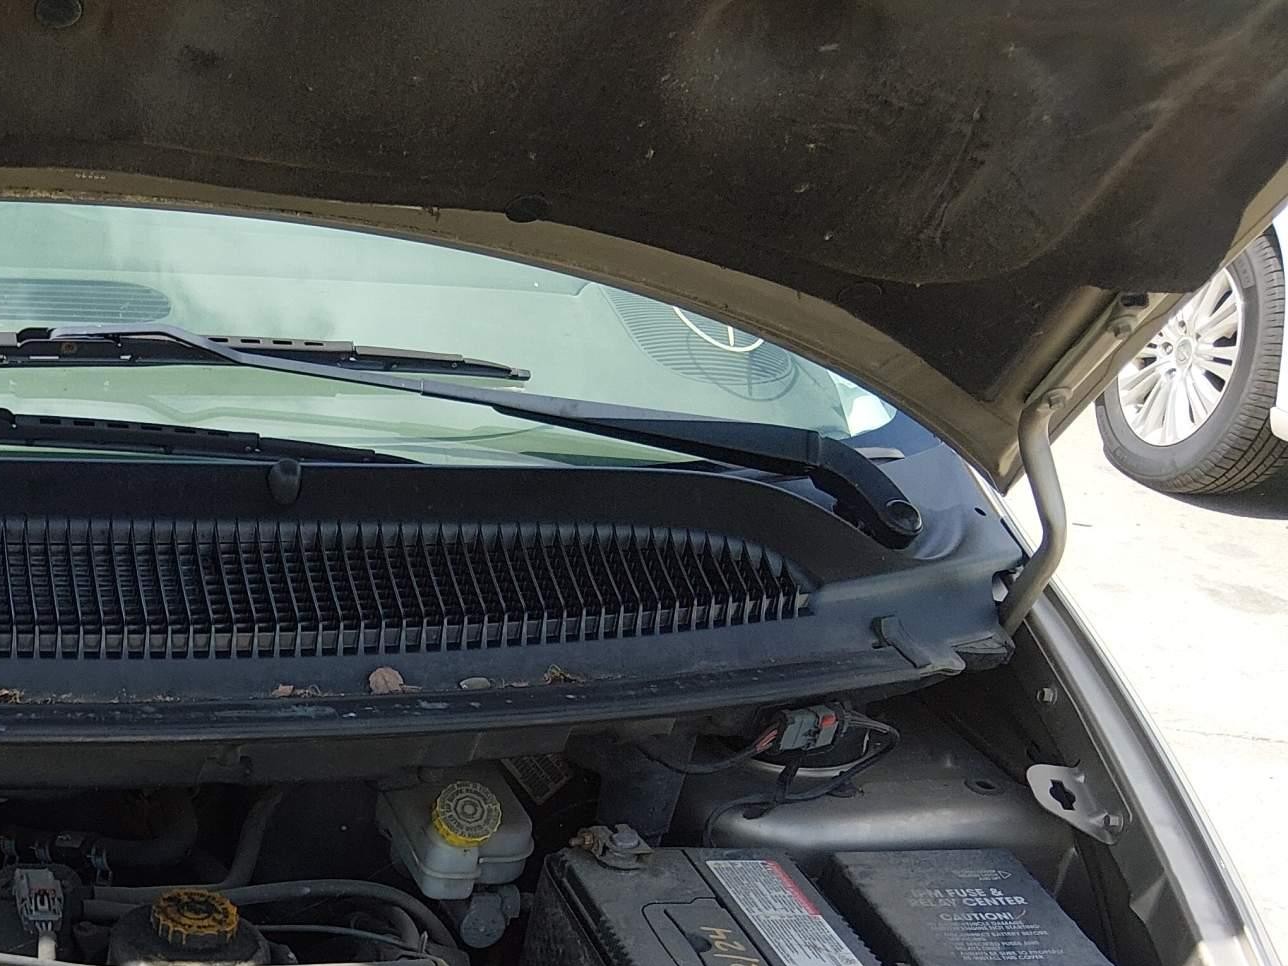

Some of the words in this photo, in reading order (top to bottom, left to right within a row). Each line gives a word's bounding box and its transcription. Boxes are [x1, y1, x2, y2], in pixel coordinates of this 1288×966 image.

[944, 888, 986, 898] FUSE
[989, 887, 1004, 897] &
[962, 897, 1029, 907] CENTER
[940, 912, 1015, 922] CAUTION!
